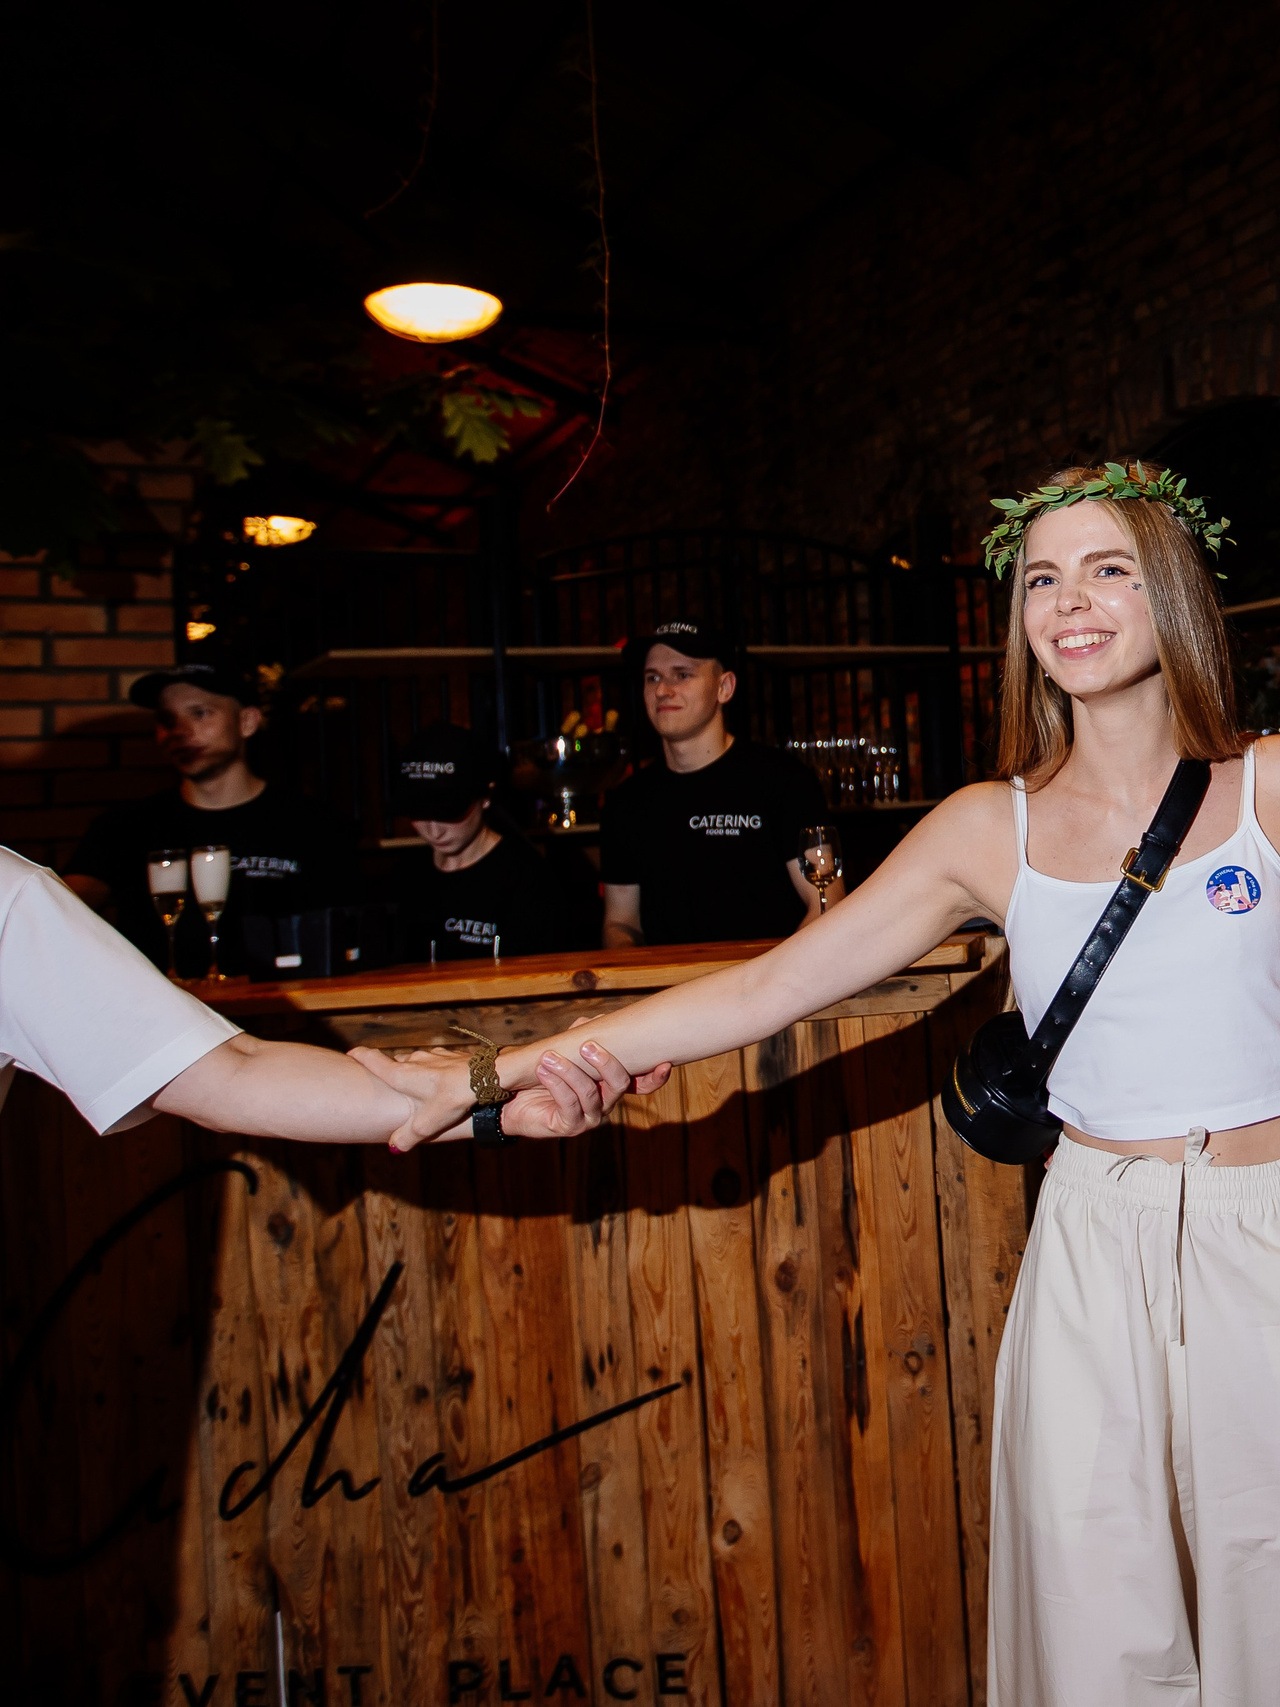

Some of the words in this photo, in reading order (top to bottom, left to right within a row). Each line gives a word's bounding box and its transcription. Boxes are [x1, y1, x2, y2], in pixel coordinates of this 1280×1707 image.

[689, 813, 763, 830] CATERING
[705, 828, 724, 836] FOOD
[725, 828, 741, 836] BOX
[230, 856, 297, 873] CATERIN
[1214, 868, 1234, 880] ATHENA
[444, 917, 497, 936] CATERI
[447, 1653, 688, 1701] PLACE
